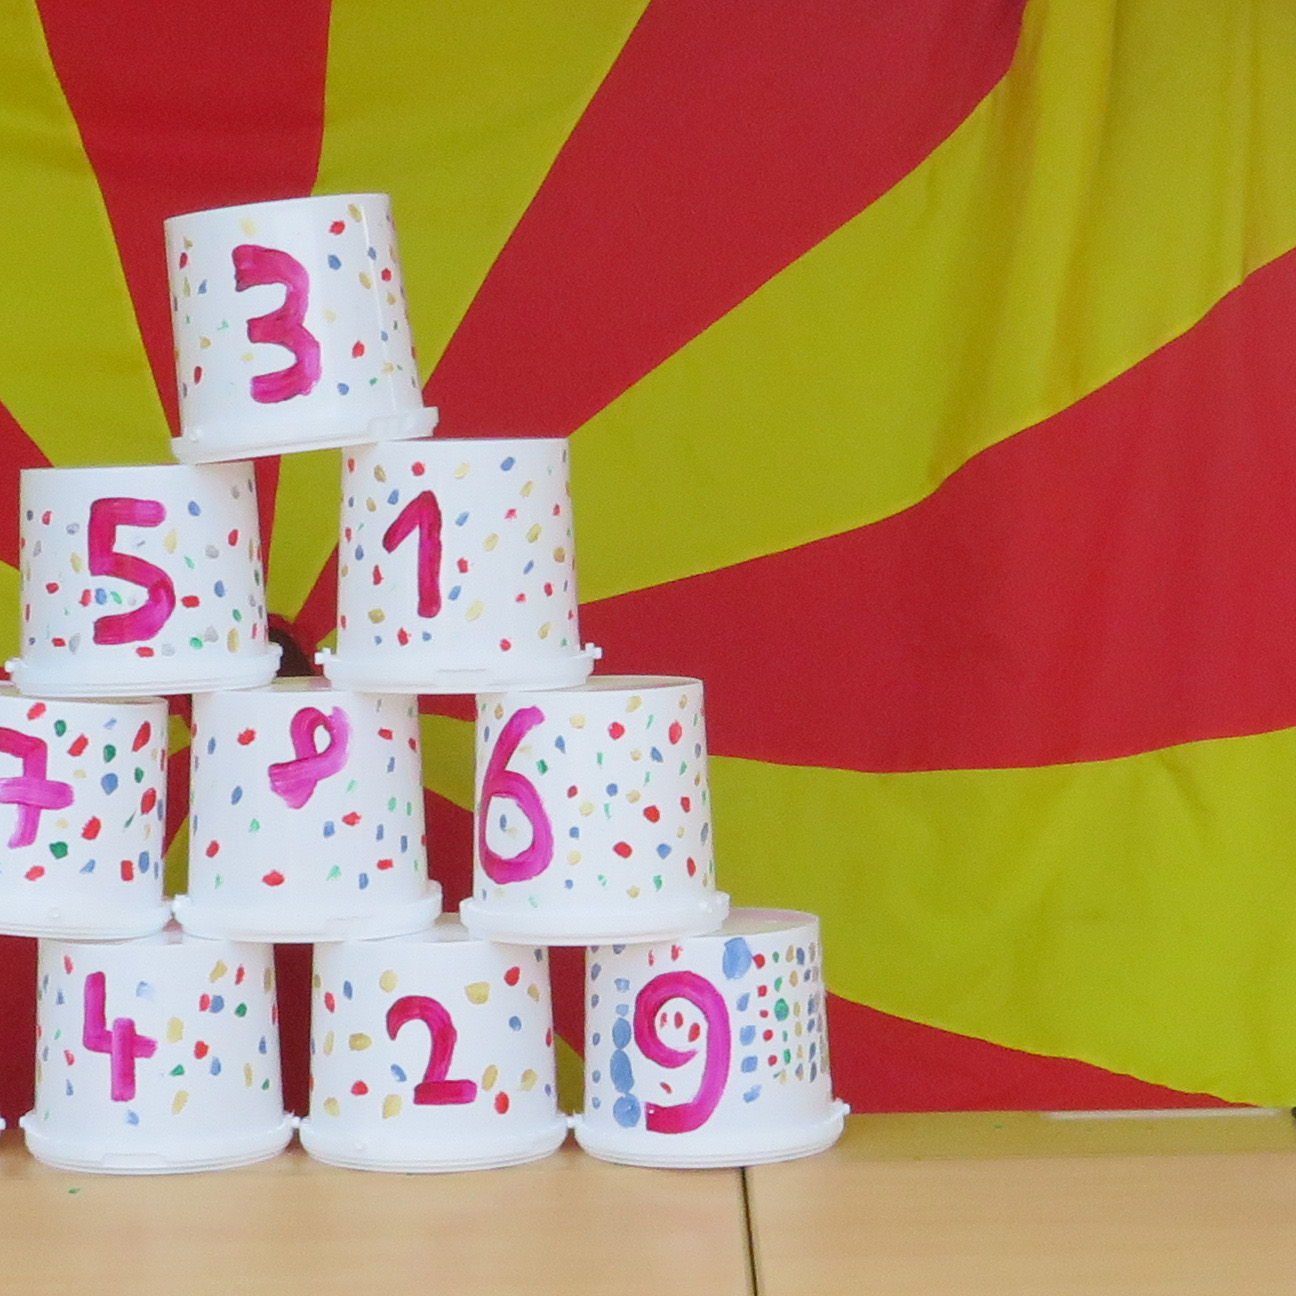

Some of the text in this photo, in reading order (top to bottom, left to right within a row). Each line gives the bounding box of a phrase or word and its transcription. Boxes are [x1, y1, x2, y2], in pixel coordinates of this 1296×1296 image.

[232, 244, 321, 404] 3
[87, 497, 176, 646] 5
[383, 490, 443, 619] 1
[478, 706, 554, 885] 6
[83, 970, 158, 1102] 4
[385, 994, 478, 1106] 2
[633, 969, 732, 1135] 9
